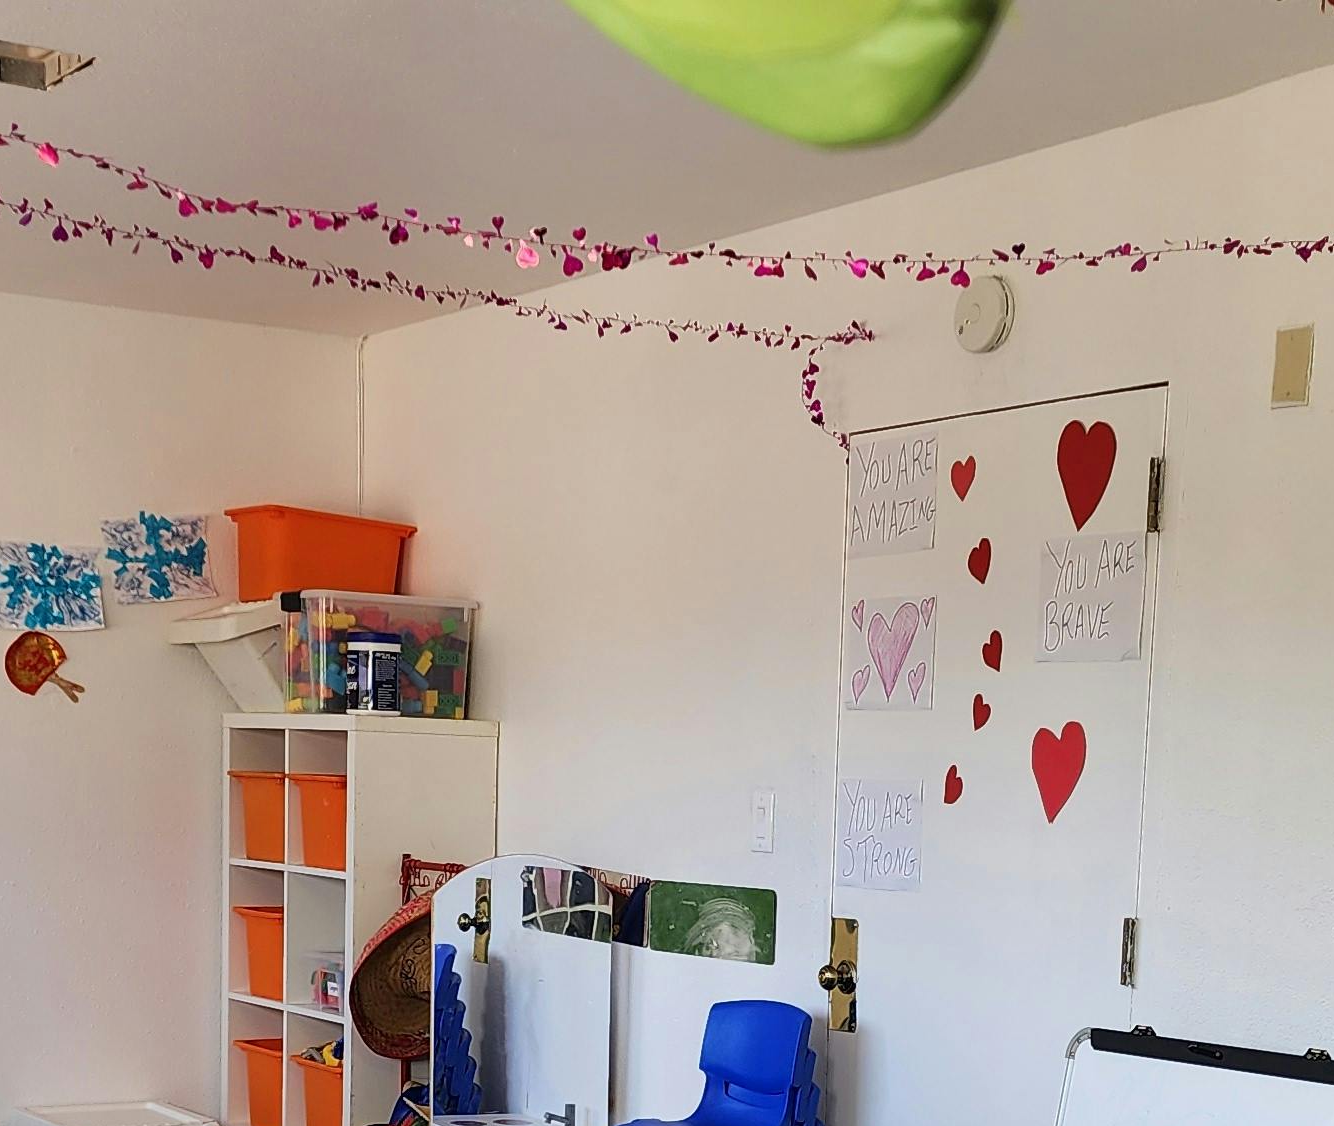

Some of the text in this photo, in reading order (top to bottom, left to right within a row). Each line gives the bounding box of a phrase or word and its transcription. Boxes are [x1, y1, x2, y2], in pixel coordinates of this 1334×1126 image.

[857, 438, 936, 497] YOU ARE
[850, 498, 937, 547] AMAZING
[1046, 540, 1136, 598] YOU ARE
[1044, 601, 1114, 652] BRAVE
[880, 794, 913, 826] ARE
[842, 836, 919, 885] STRONG
